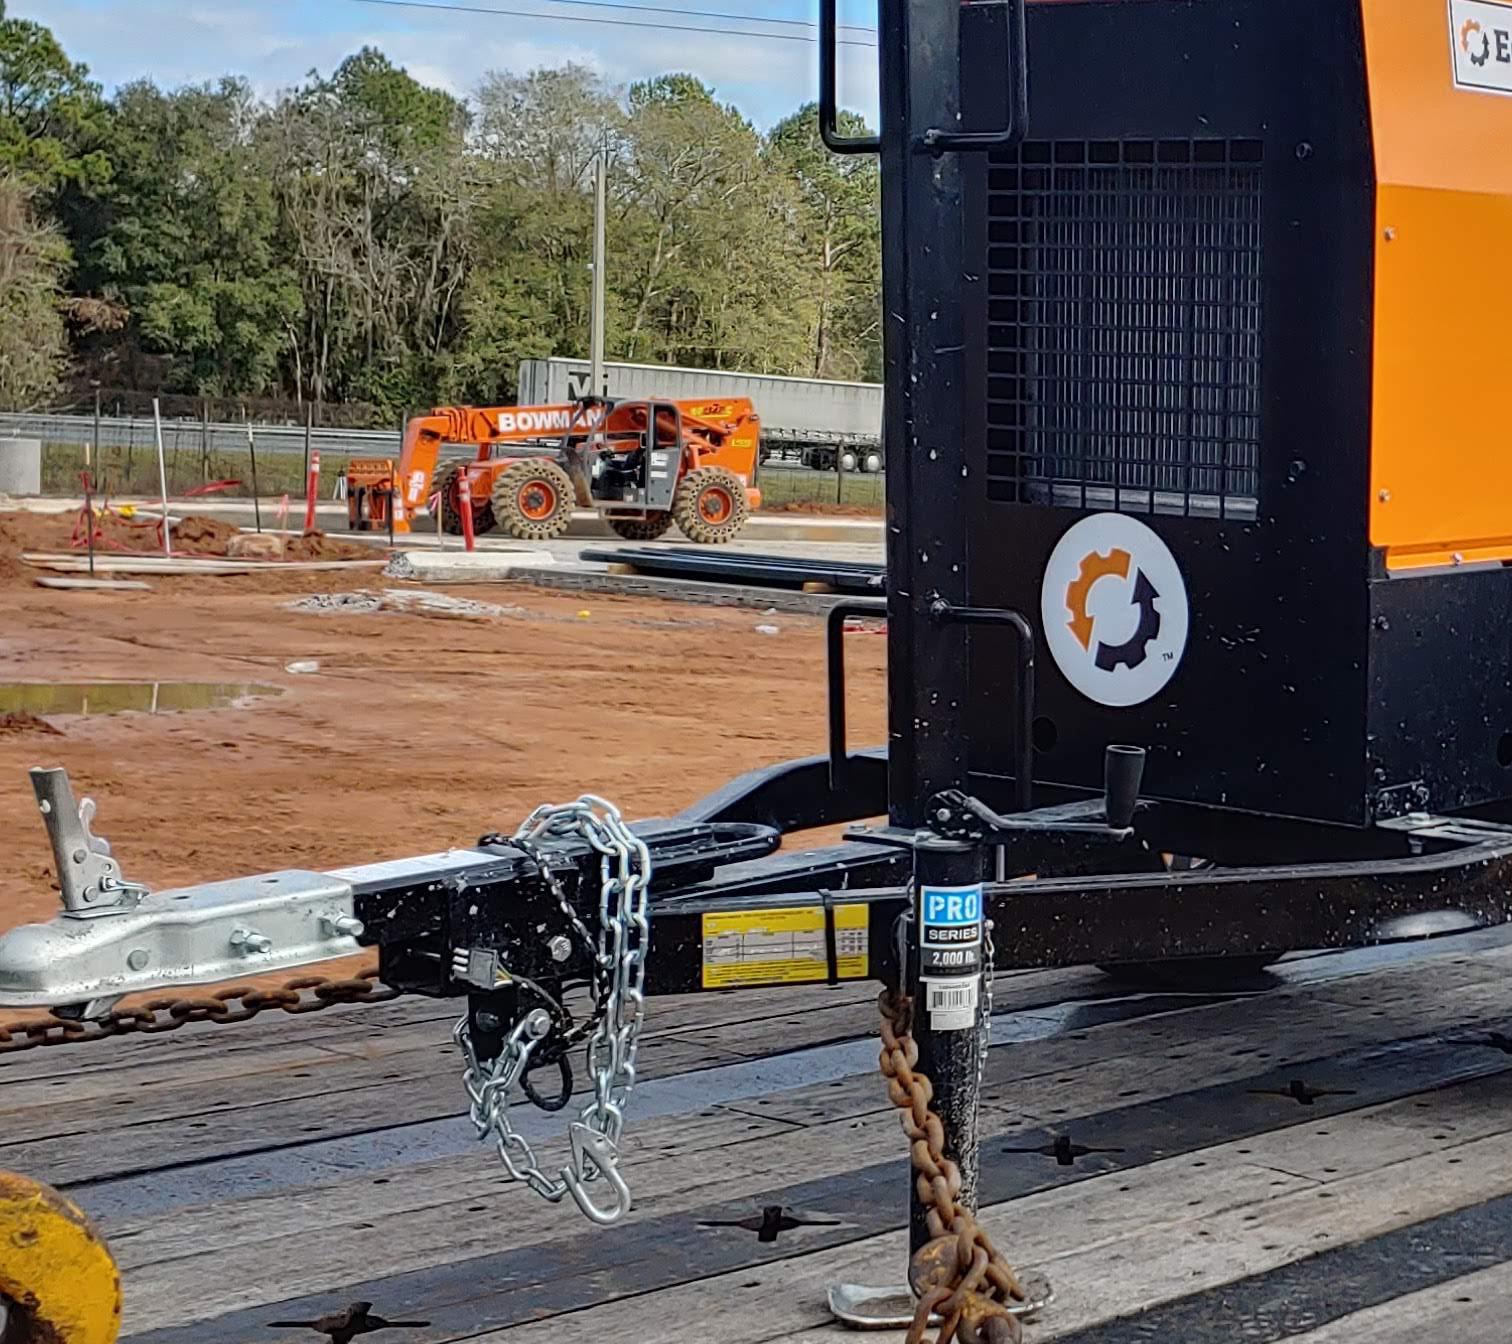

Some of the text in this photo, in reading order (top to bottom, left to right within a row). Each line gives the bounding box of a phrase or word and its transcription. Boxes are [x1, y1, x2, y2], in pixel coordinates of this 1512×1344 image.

[498, 408, 604, 432] BOWMAN
[929, 894, 978, 921] PRO
[928, 926, 978, 940] SERIES
[932, 951, 963, 966] 2,000
